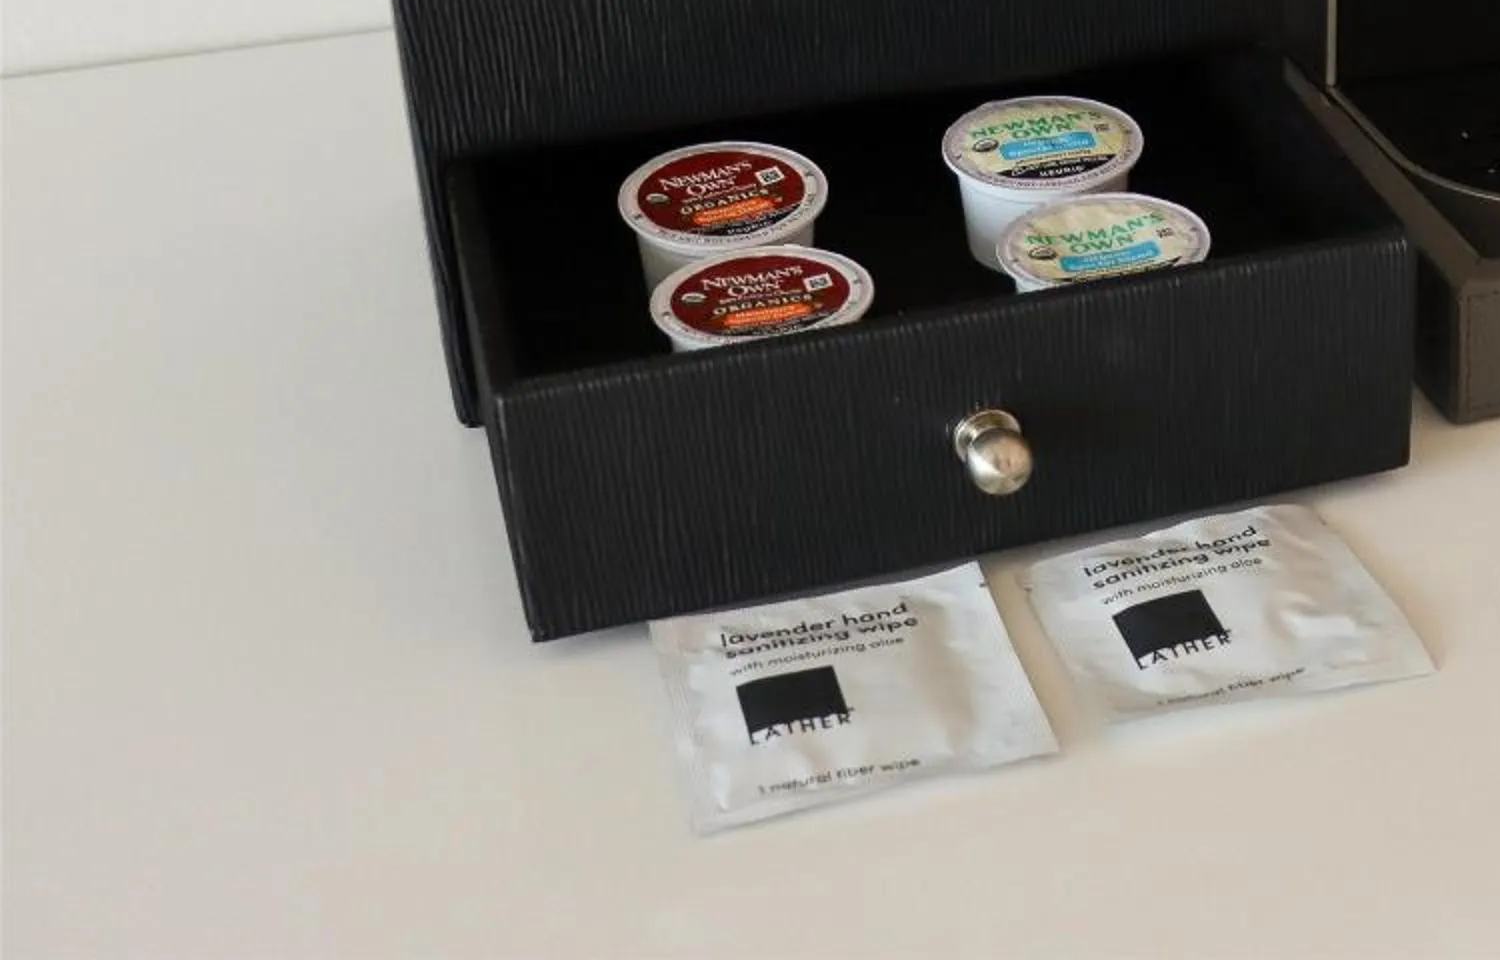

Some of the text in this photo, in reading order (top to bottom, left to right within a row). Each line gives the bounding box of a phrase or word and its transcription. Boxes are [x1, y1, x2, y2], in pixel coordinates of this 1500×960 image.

[971, 111, 1102, 139] NEWMAN'S
[1011, 121, 1072, 139] OWN
[659, 160, 753, 191] NEWMAN'S
[686, 176, 736, 197] OWN
[680, 188, 769, 216] ORGANICS
[1024, 211, 1166, 246] NEWMAN'S
[1070, 234, 1134, 254] OWN
[702, 264, 804, 291] NEWMAN'S
[727, 281, 781, 298] OWN
[712, 293, 813, 316] ORGANICS
[1083, 524, 1258, 578] lavender hand
[1092, 538, 1272, 589] sanitizing wipe
[1102, 556, 1264, 606] with moisturizing aloe
[719, 601, 909, 649] lavender hand
[725, 616, 919, 659] sanitizing wipe
[728, 659, 765, 677] with
[767, 643, 867, 667] moisturizing
[1135, 631, 1233, 671] LATHER
[750, 712, 853, 747] LATHER
[768, 771, 832, 793] natural
